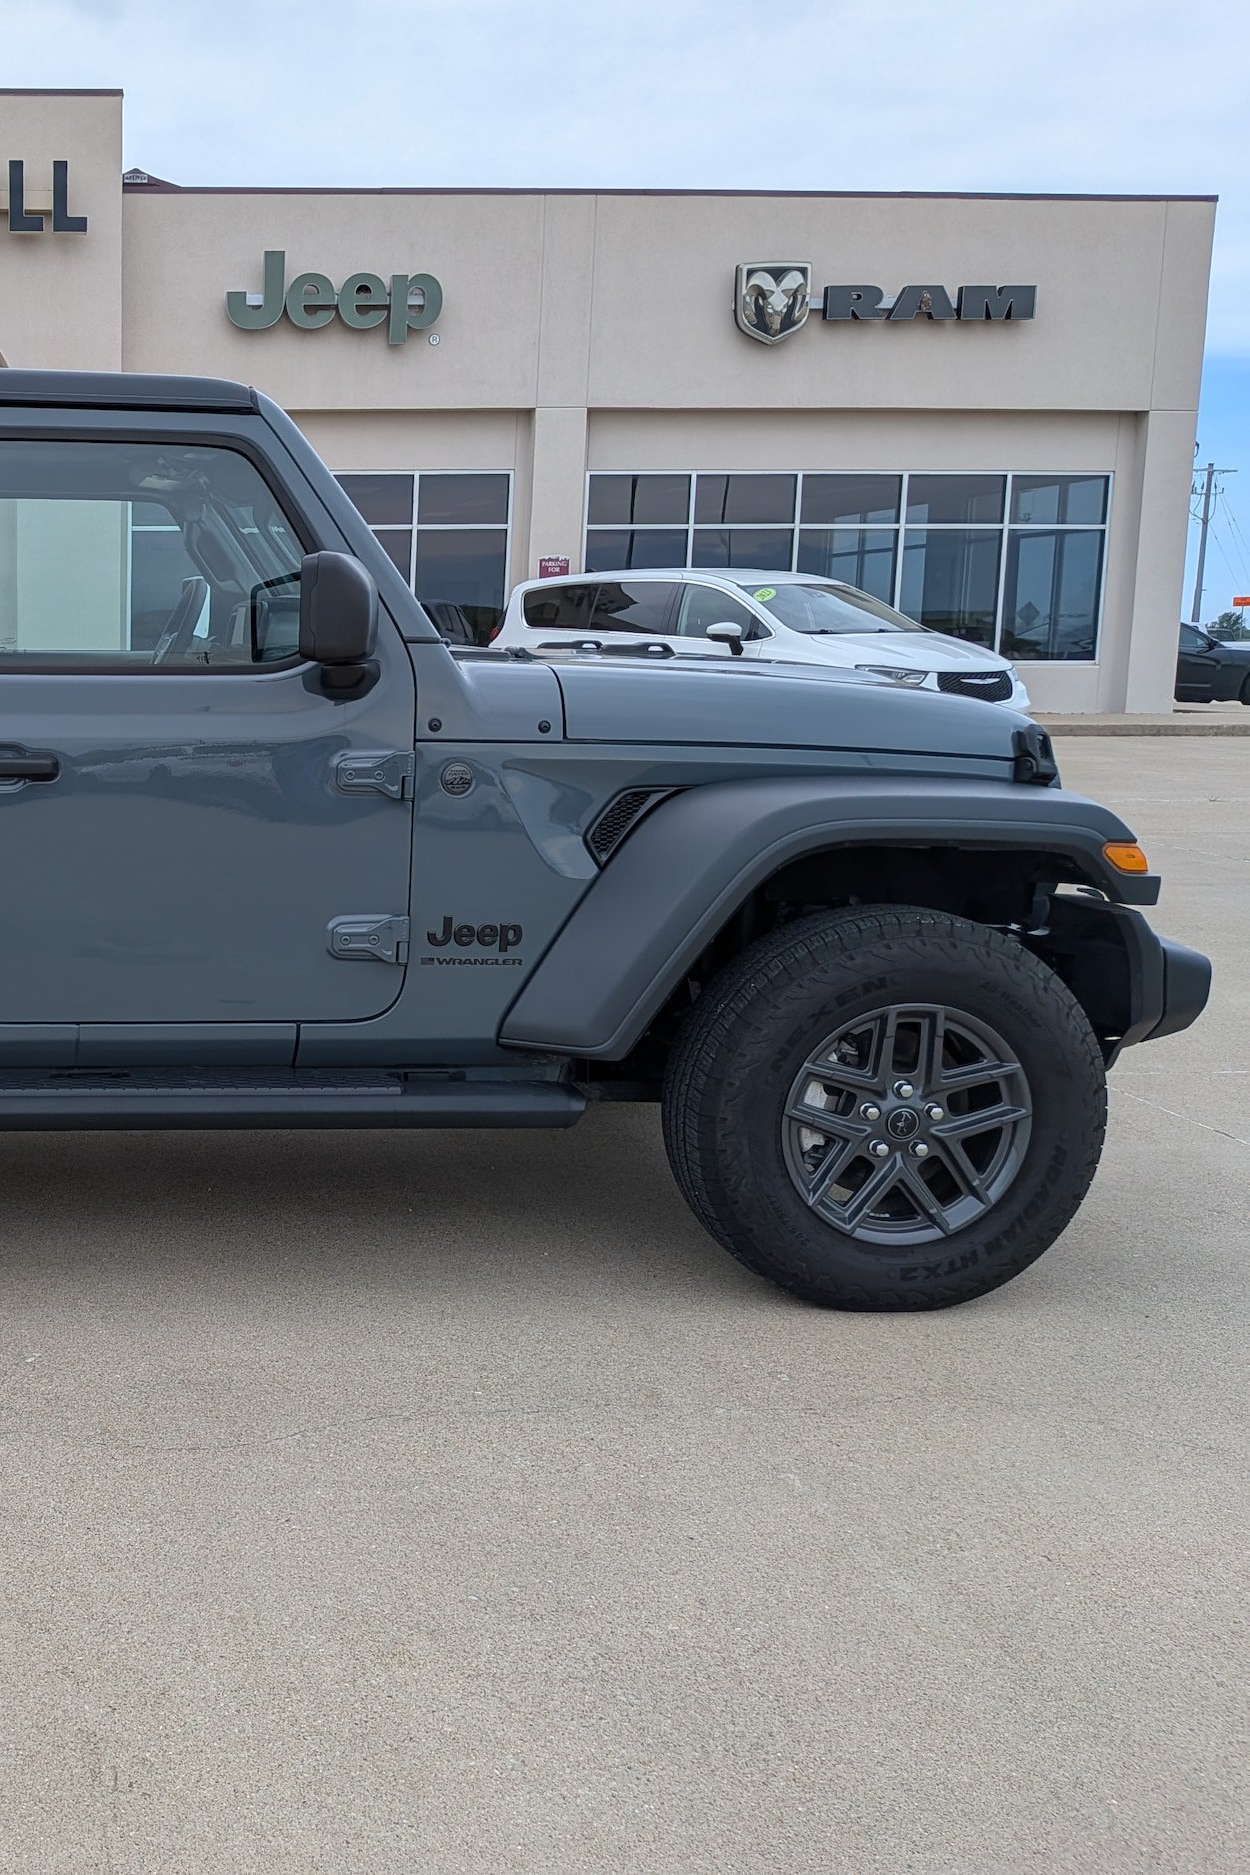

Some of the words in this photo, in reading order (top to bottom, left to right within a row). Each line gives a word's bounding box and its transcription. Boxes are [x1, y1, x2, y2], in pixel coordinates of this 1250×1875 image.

[226, 250, 443, 344] Jeep
[822, 284, 1038, 320] RAM
[427, 915, 523, 952] Jeep
[436, 957, 523, 966] WRANGLER
